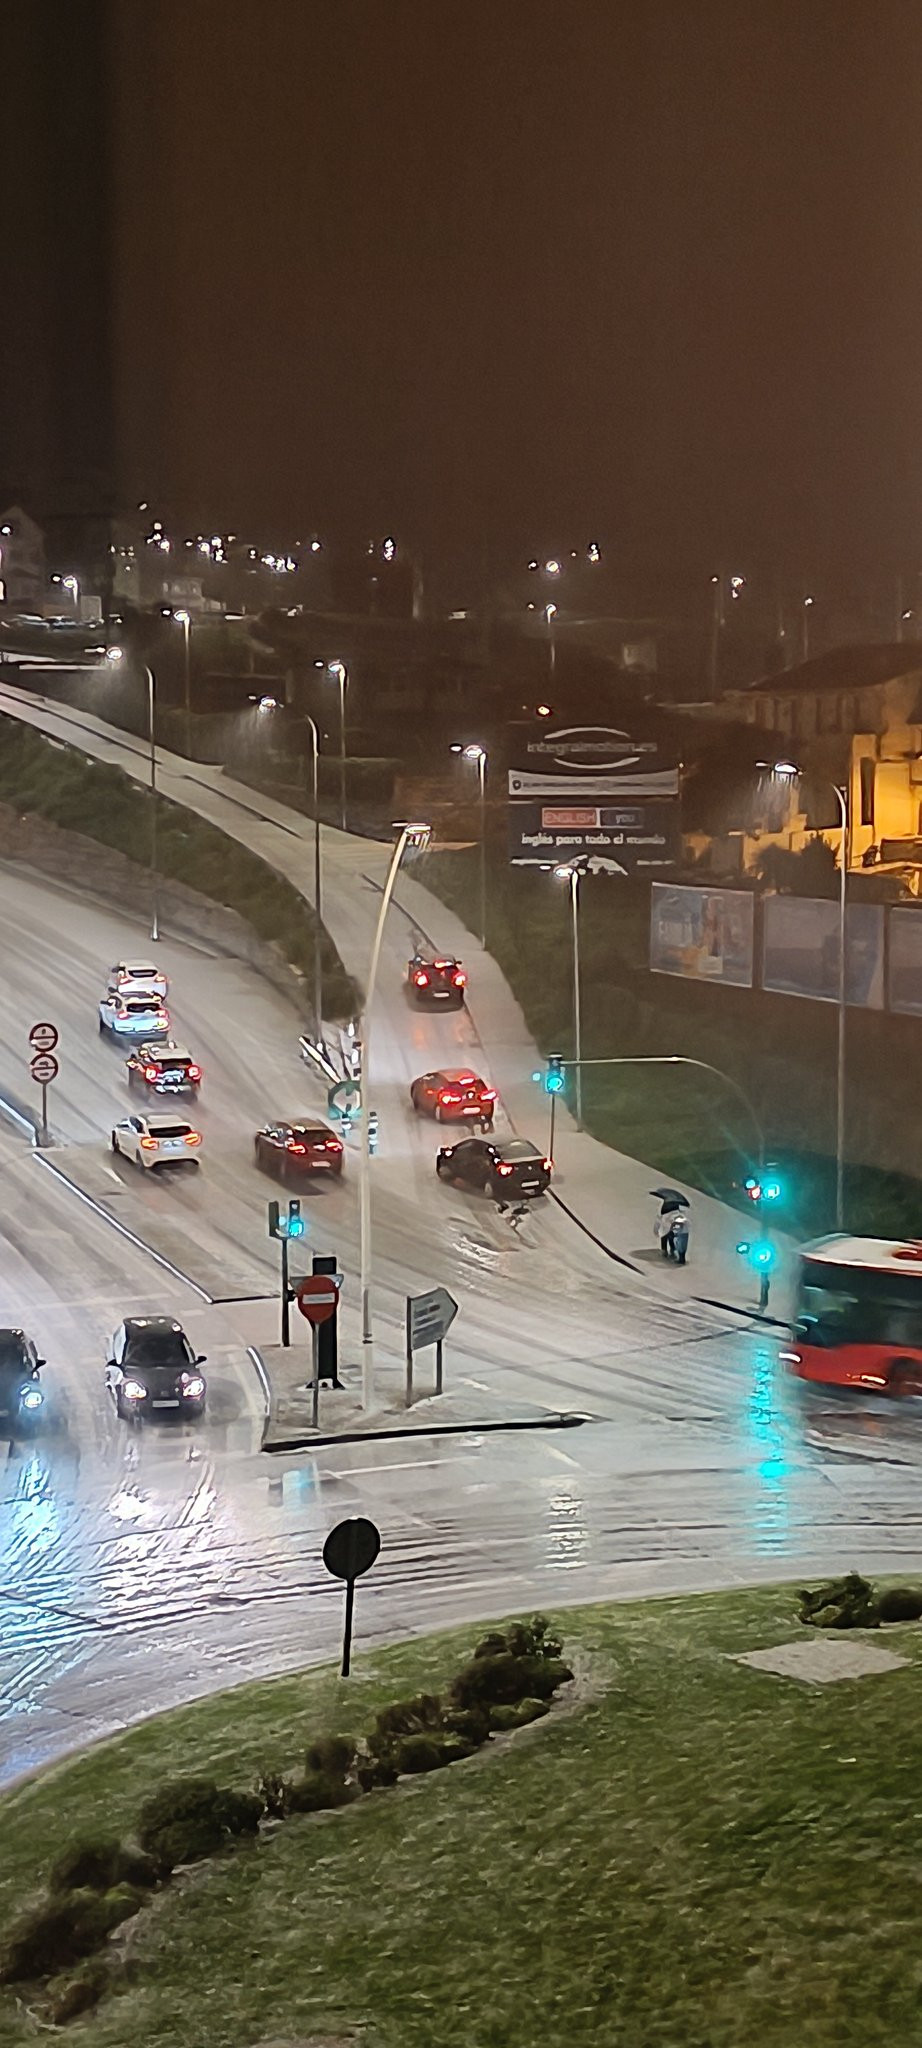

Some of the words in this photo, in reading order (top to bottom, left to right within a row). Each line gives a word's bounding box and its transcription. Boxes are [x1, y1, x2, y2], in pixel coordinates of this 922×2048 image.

[543, 811, 596, 824] ENGLISH
[556, 835, 582, 846] para
[586, 833, 611, 845] todo
[613, 833, 624, 845] el
[627, 834, 665, 845] mundo
